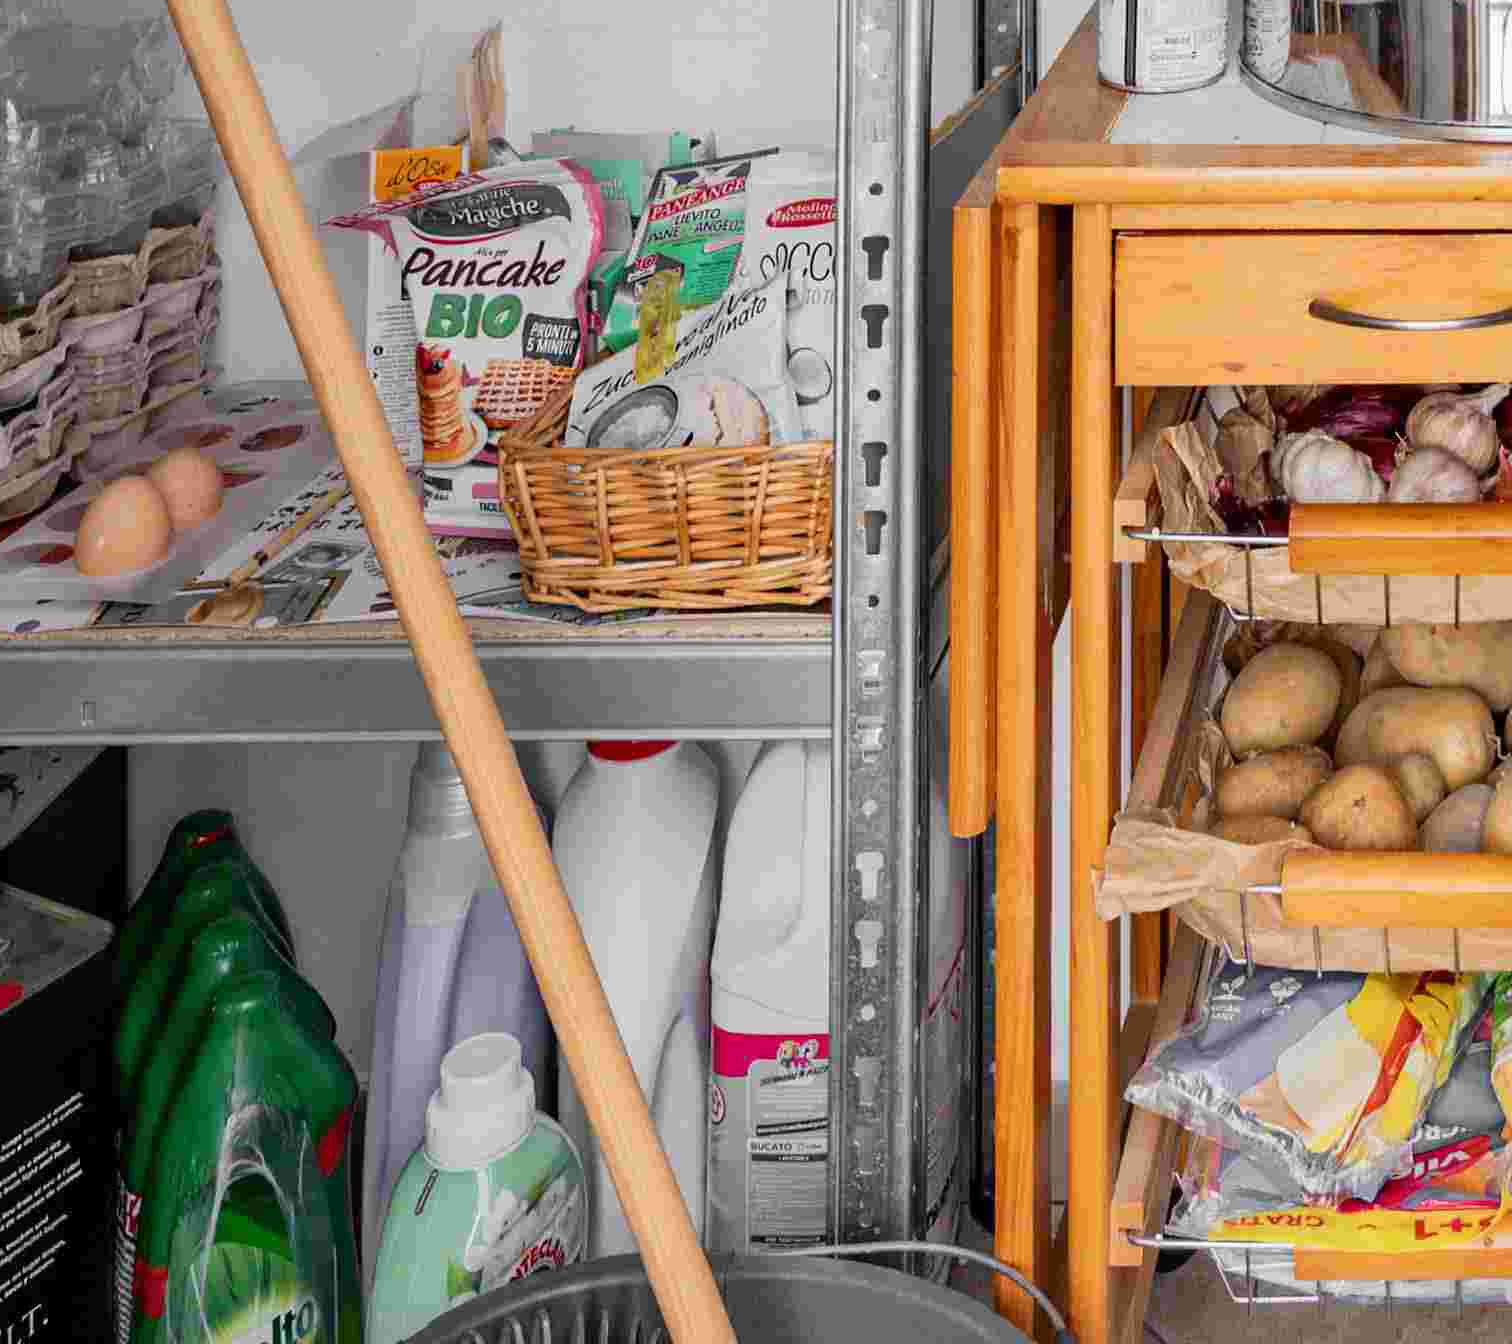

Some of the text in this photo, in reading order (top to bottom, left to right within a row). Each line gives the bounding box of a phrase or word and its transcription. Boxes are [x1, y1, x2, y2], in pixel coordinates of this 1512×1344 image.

[450, 197, 540, 229] Magiche
[400, 239, 567, 301] Pancake
[425, 293, 523, 338] BIO
[526, 337, 535, 351] 5
